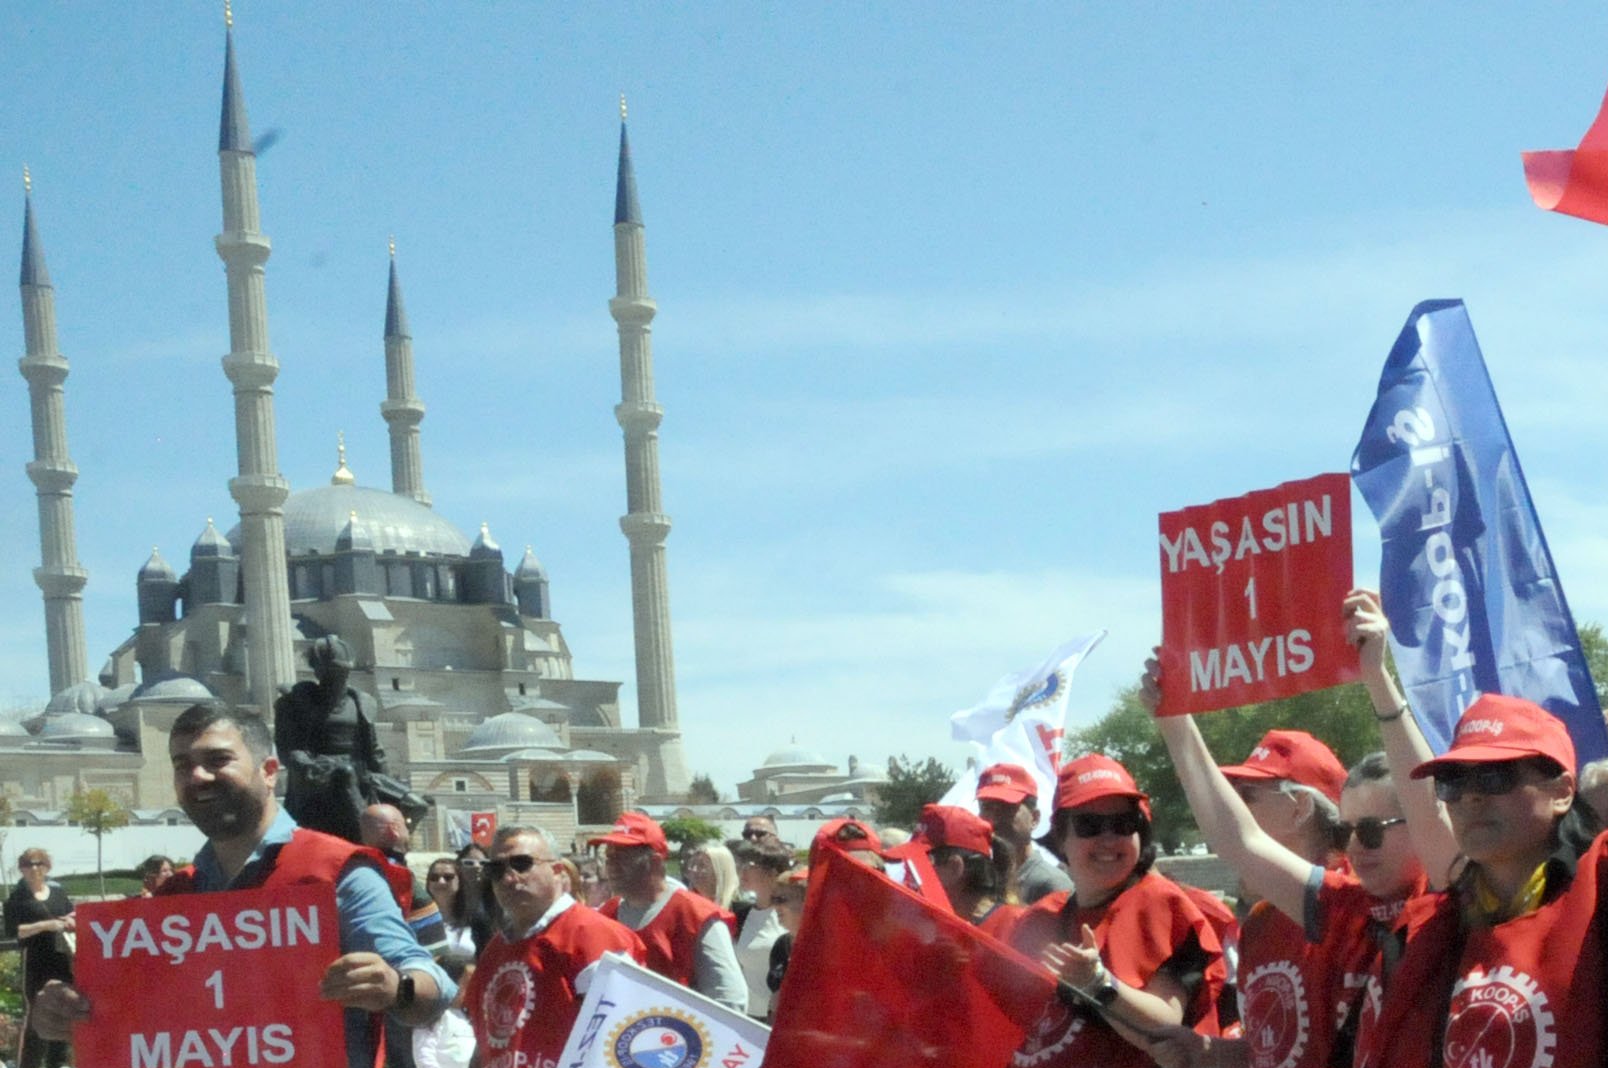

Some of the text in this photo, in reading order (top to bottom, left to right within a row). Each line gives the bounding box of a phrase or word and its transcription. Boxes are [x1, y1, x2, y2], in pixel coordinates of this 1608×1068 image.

[1159, 494, 1333, 575] YAŞASIN
[1244, 576, 1257, 621] 1
[1189, 628, 1315, 693] MAYIS
[89, 904, 321, 965] YAŞASIN
[205, 971, 225, 1009] 1
